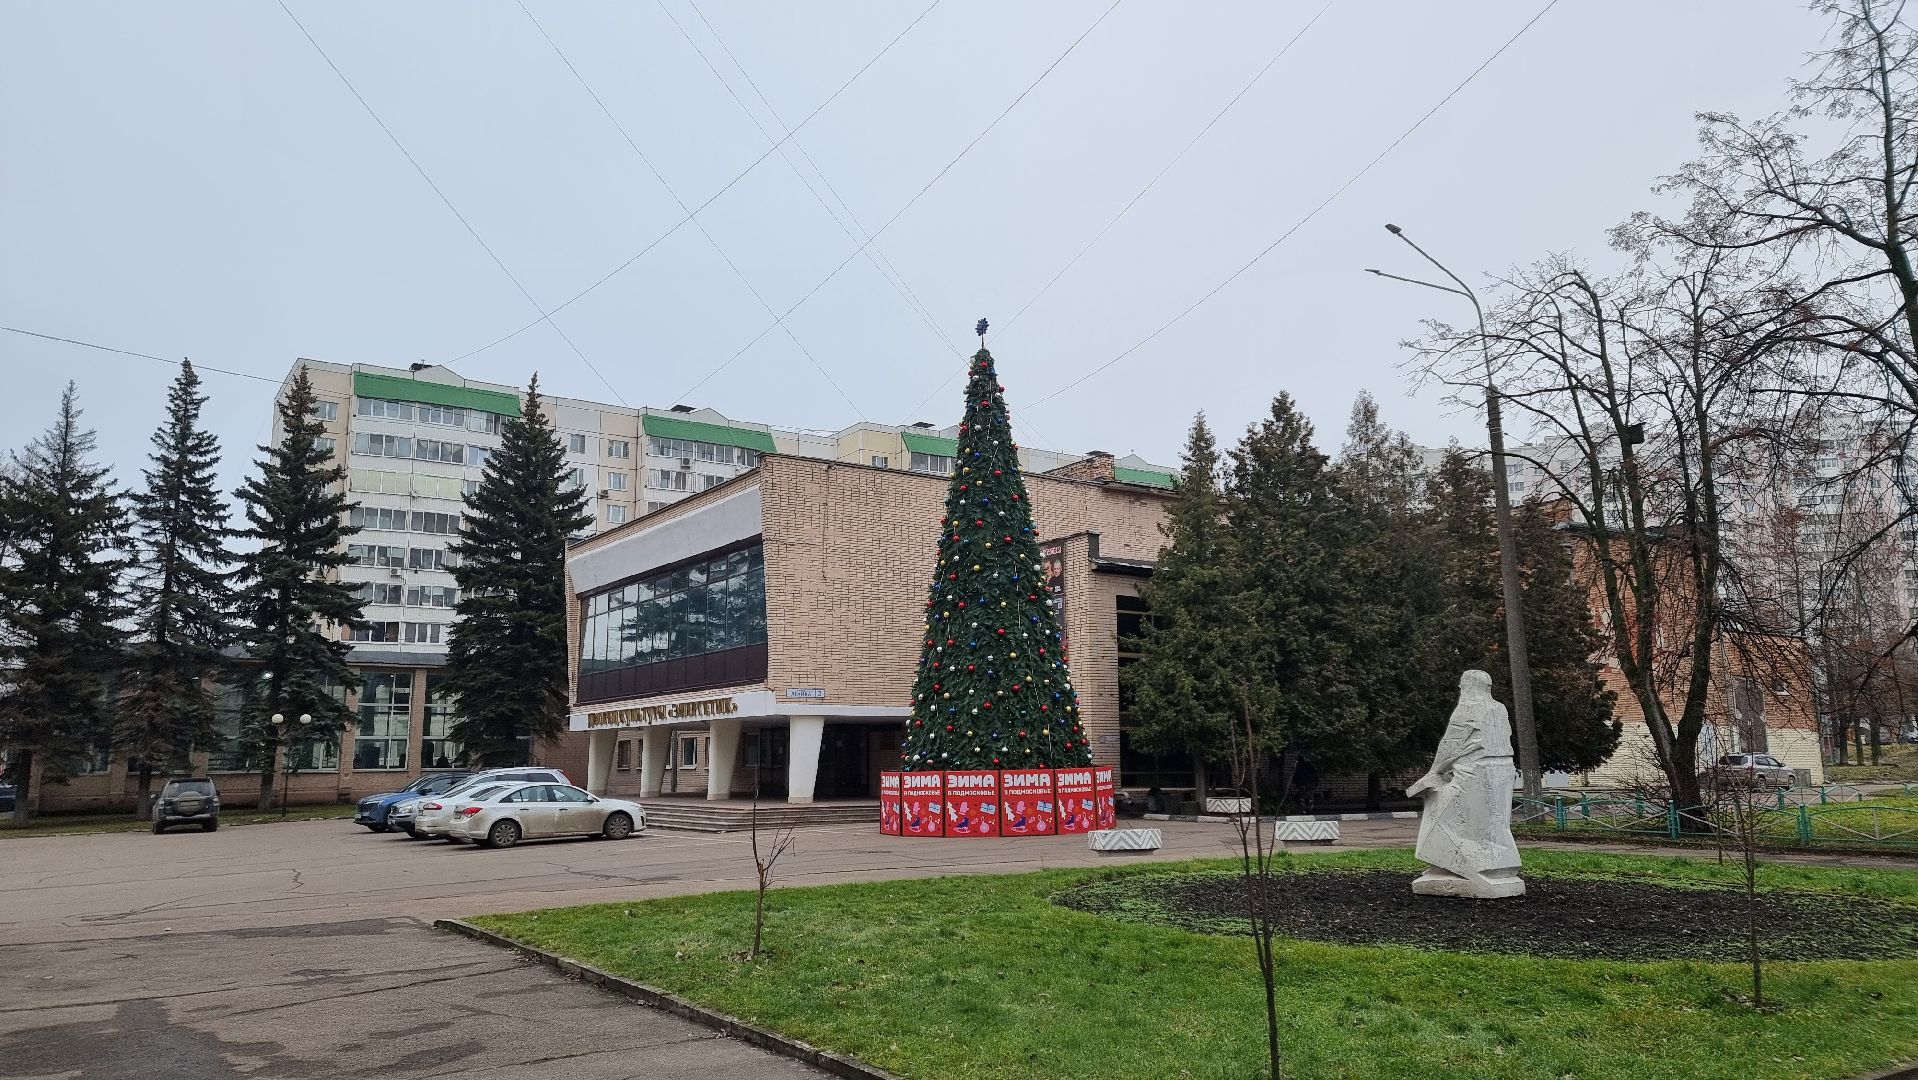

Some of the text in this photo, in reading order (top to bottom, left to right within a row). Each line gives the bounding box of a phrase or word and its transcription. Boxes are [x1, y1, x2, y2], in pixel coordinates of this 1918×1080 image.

[903, 775, 941, 789] ЗИМА
[947, 774, 995, 788] ЗИМА
[1003, 773, 1051, 787] ЗИМА
[1058, 772, 1092, 786] ЗИМА
[1009, 788, 1052, 796] ПОДМОСКОВЬЕ
